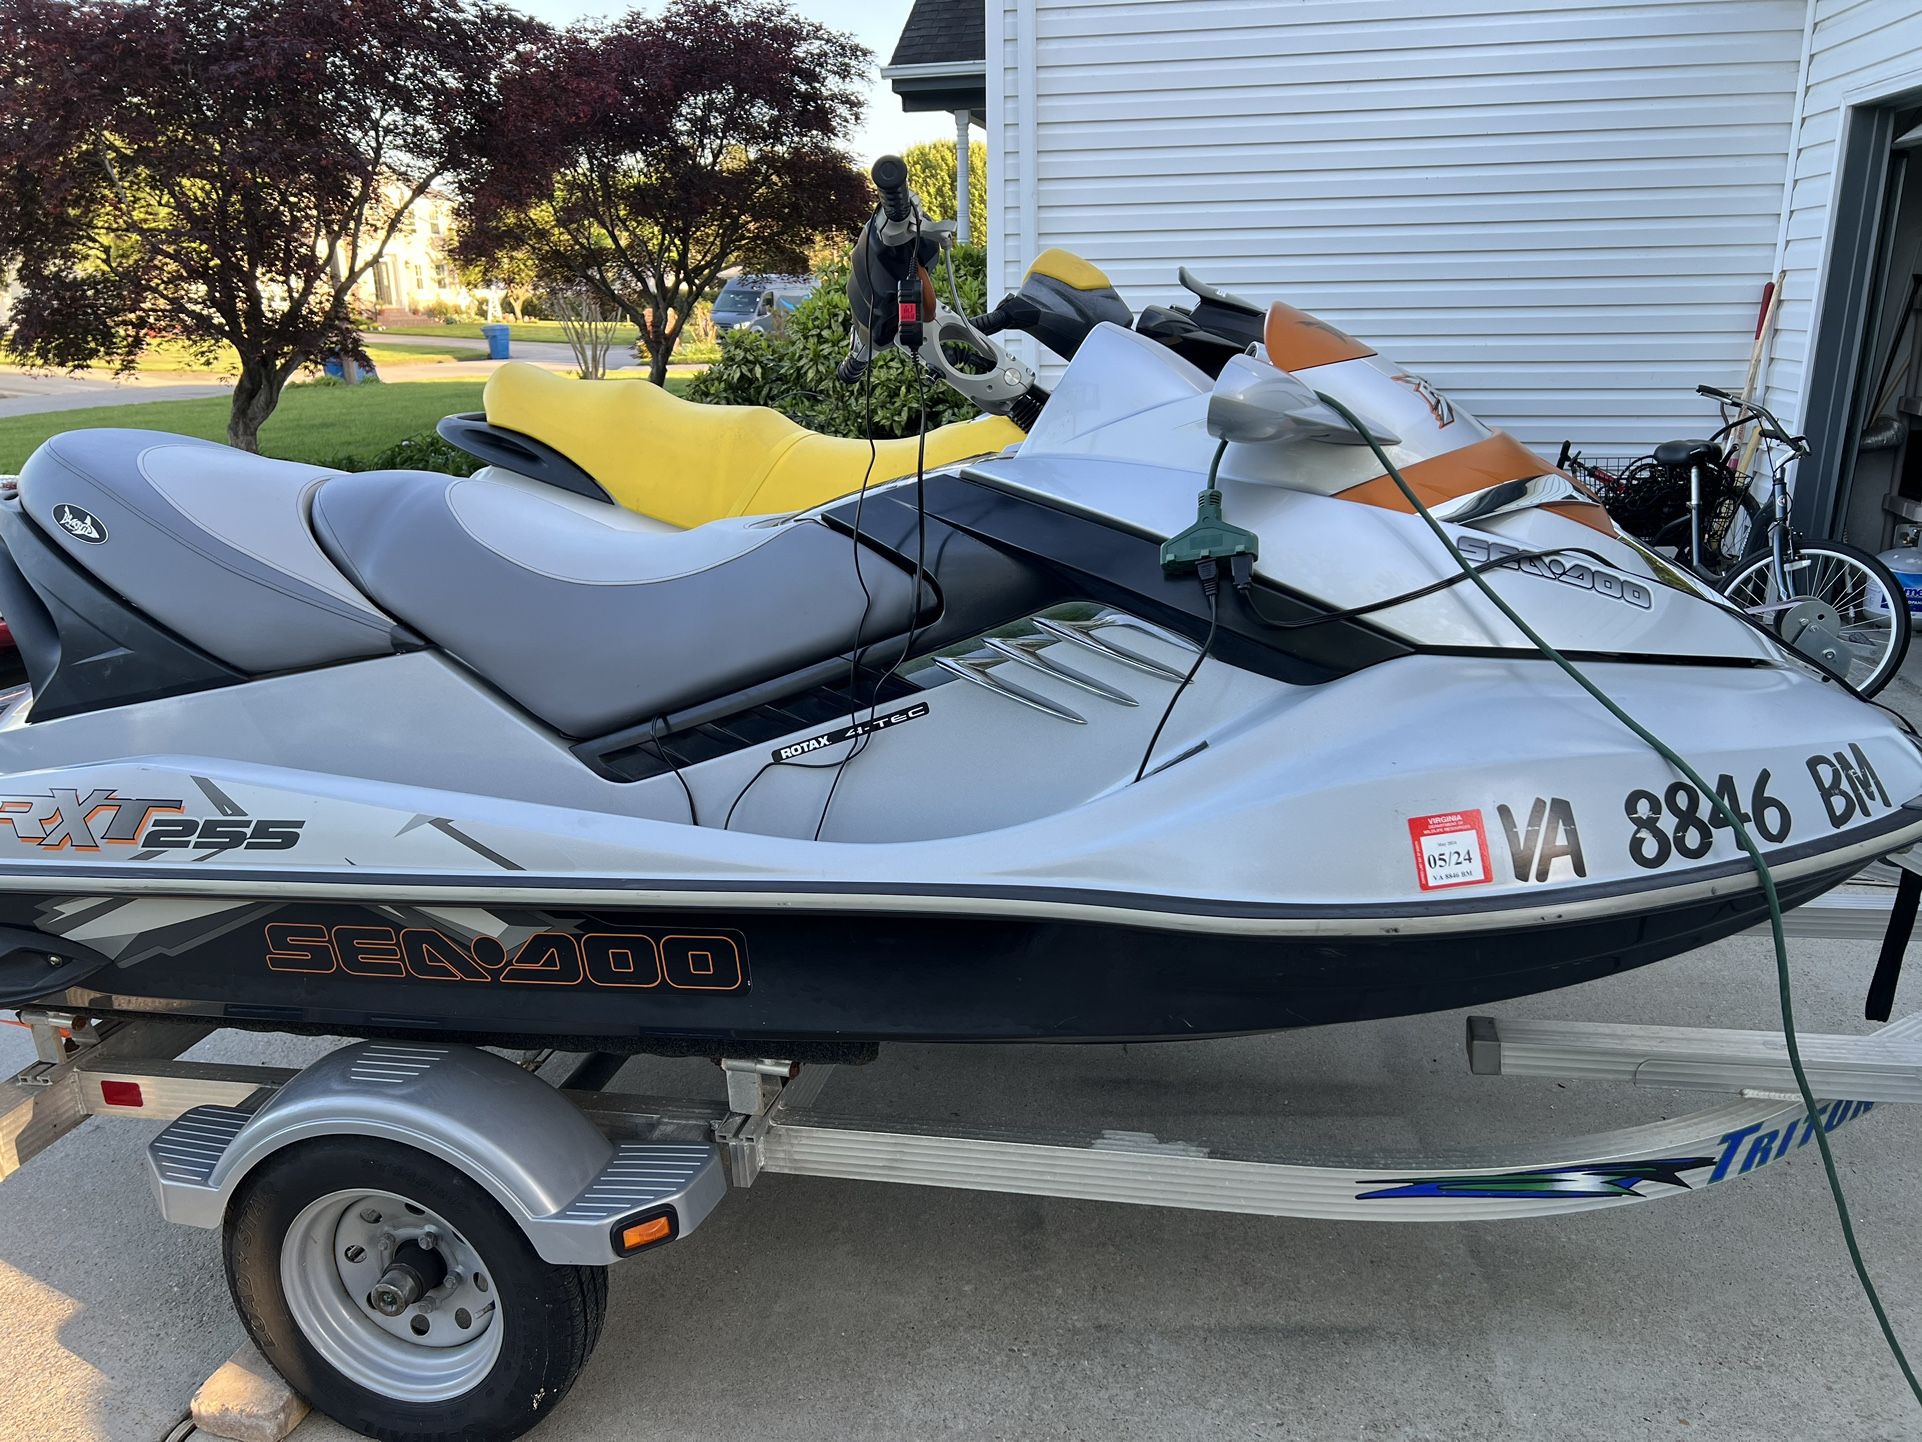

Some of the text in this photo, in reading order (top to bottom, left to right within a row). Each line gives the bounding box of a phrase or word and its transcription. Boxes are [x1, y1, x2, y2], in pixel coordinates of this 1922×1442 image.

[780, 735, 832, 760] ROTAX
[0, 787, 185, 851] RXT
[1428, 814, 1462, 825] VIRGINIA
[1497, 797, 1587, 883] VA
[1624, 767, 1791, 869] 8846
[1805, 743, 1892, 829] BM
[141, 819, 305, 850] 255
[1427, 849, 1473, 869] 05/24
[1433, 870, 1473, 881] VA 8846 BM
